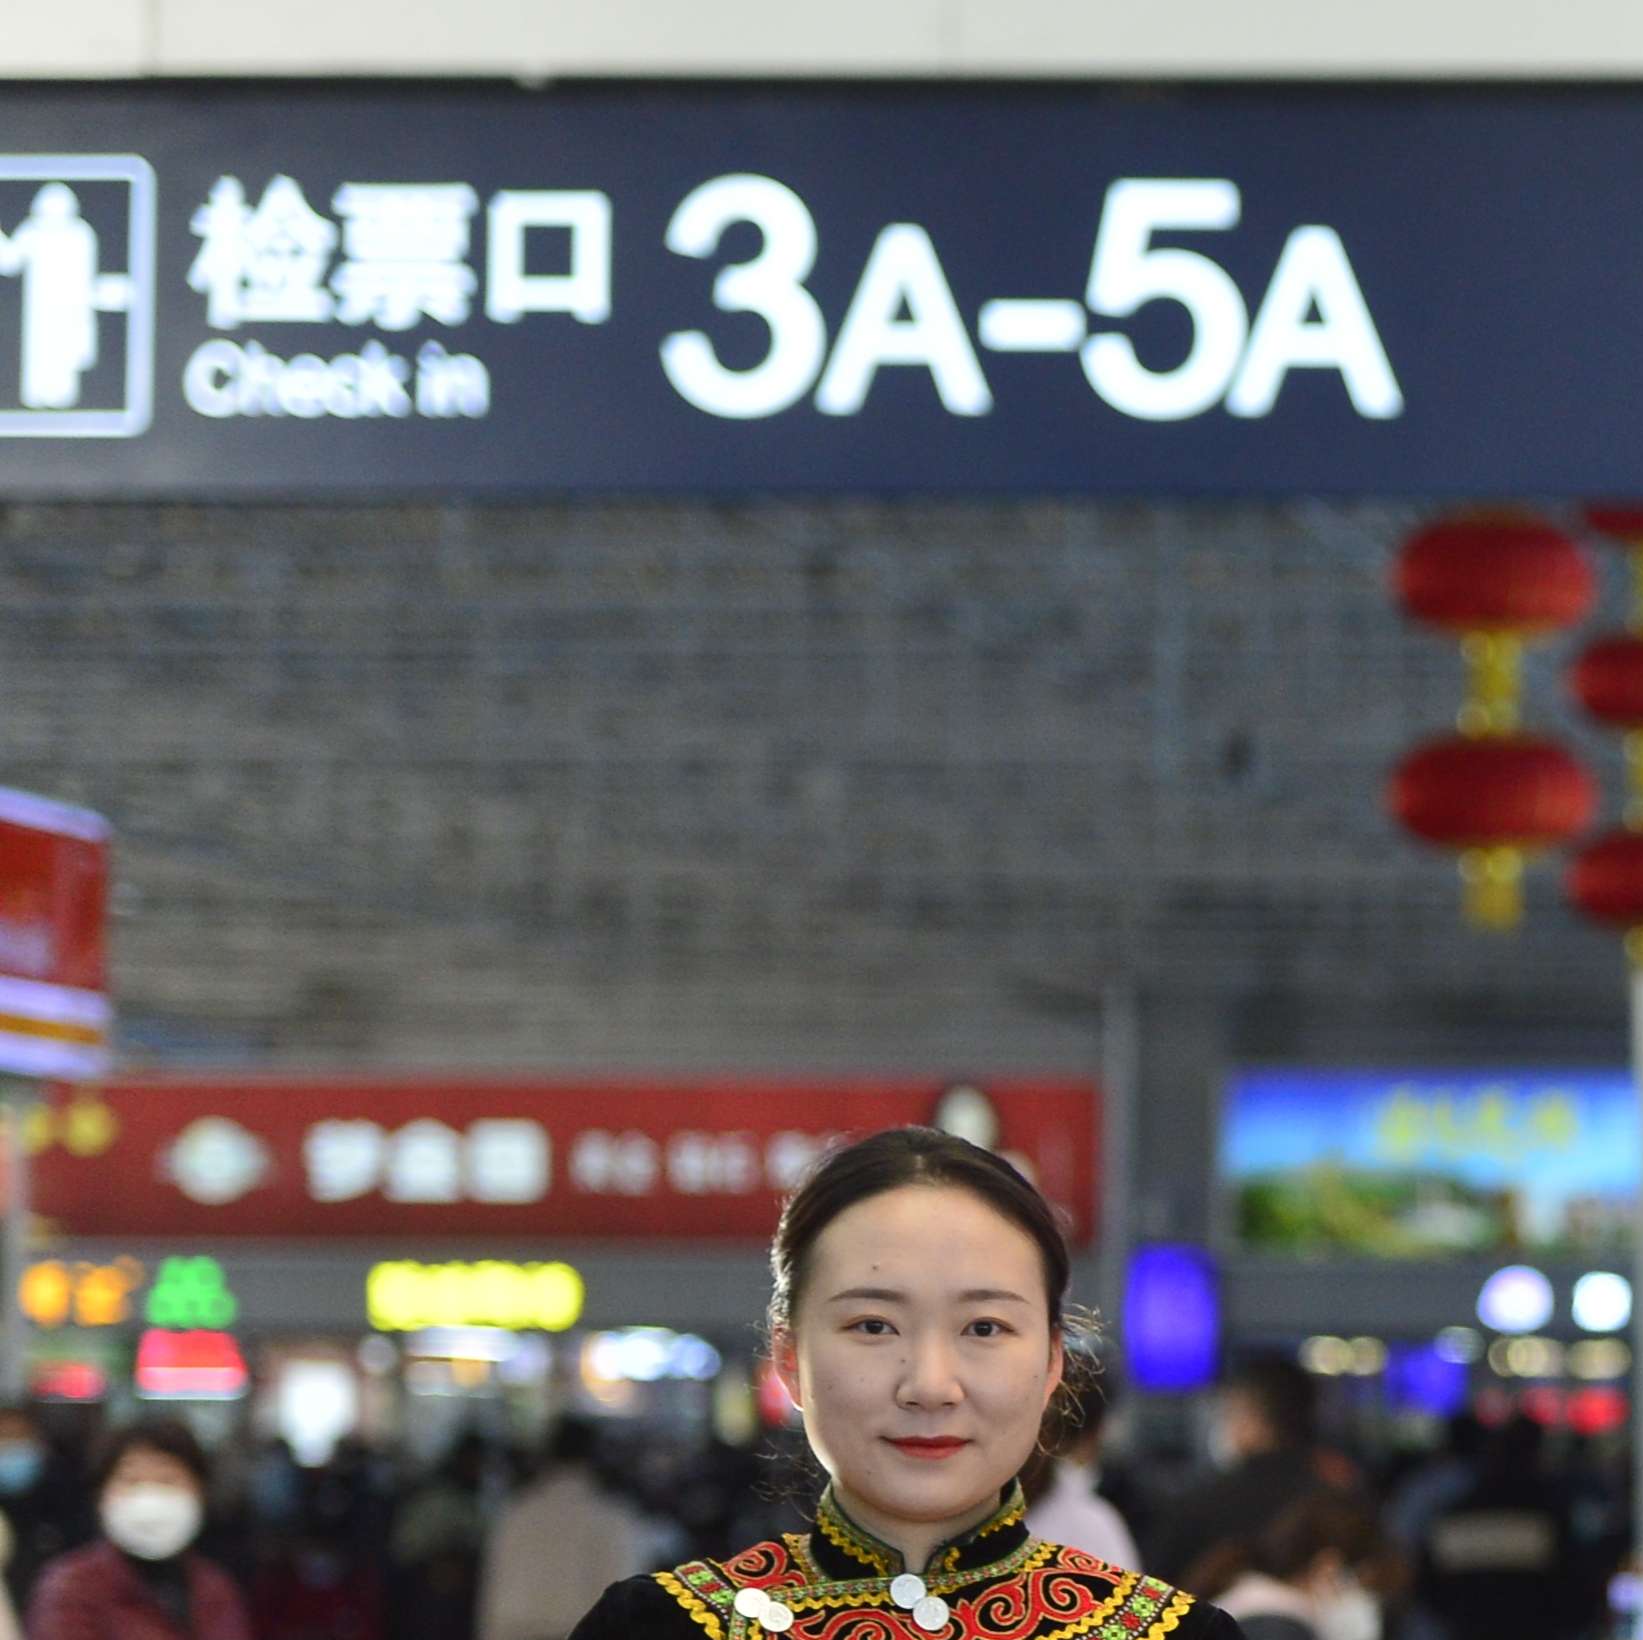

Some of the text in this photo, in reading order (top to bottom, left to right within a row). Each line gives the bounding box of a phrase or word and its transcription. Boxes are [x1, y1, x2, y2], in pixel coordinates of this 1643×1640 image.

[187, 172, 612, 329] 检票口
[659, 173, 1404, 420] 3A-5A
[184, 337, 491, 418] Check in
